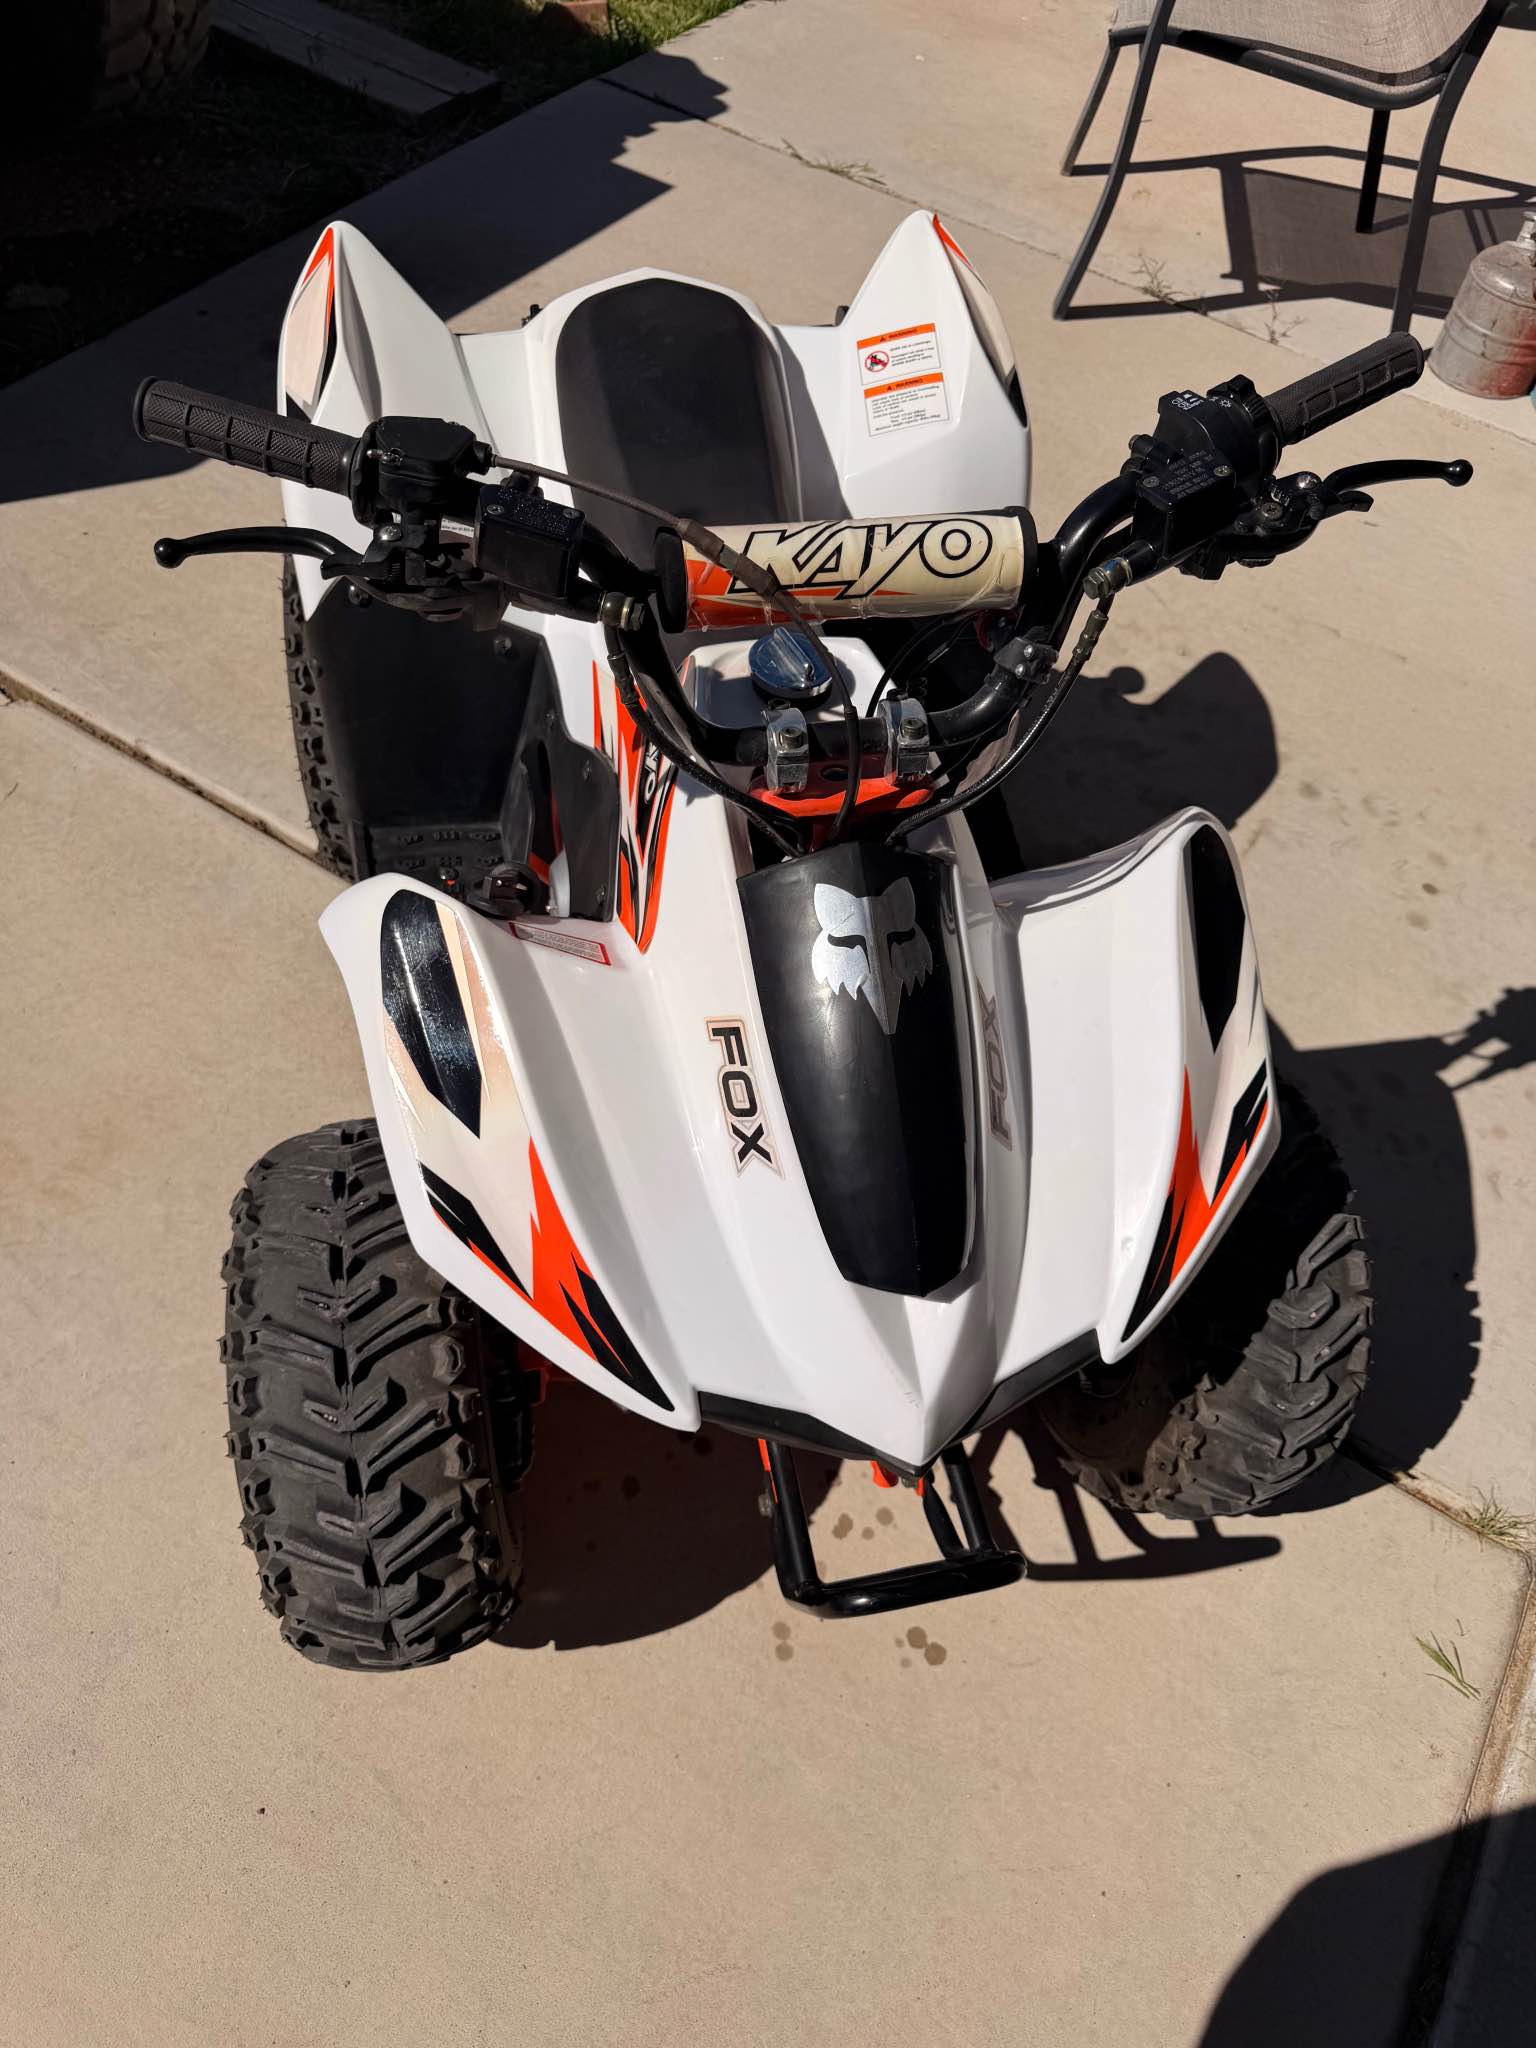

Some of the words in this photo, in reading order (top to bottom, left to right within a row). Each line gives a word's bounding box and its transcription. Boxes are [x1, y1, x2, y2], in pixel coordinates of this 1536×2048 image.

[727, 518, 993, 599] KAYO
[710, 1024, 774, 1167] FOX
[977, 985, 1011, 1144] FOX
